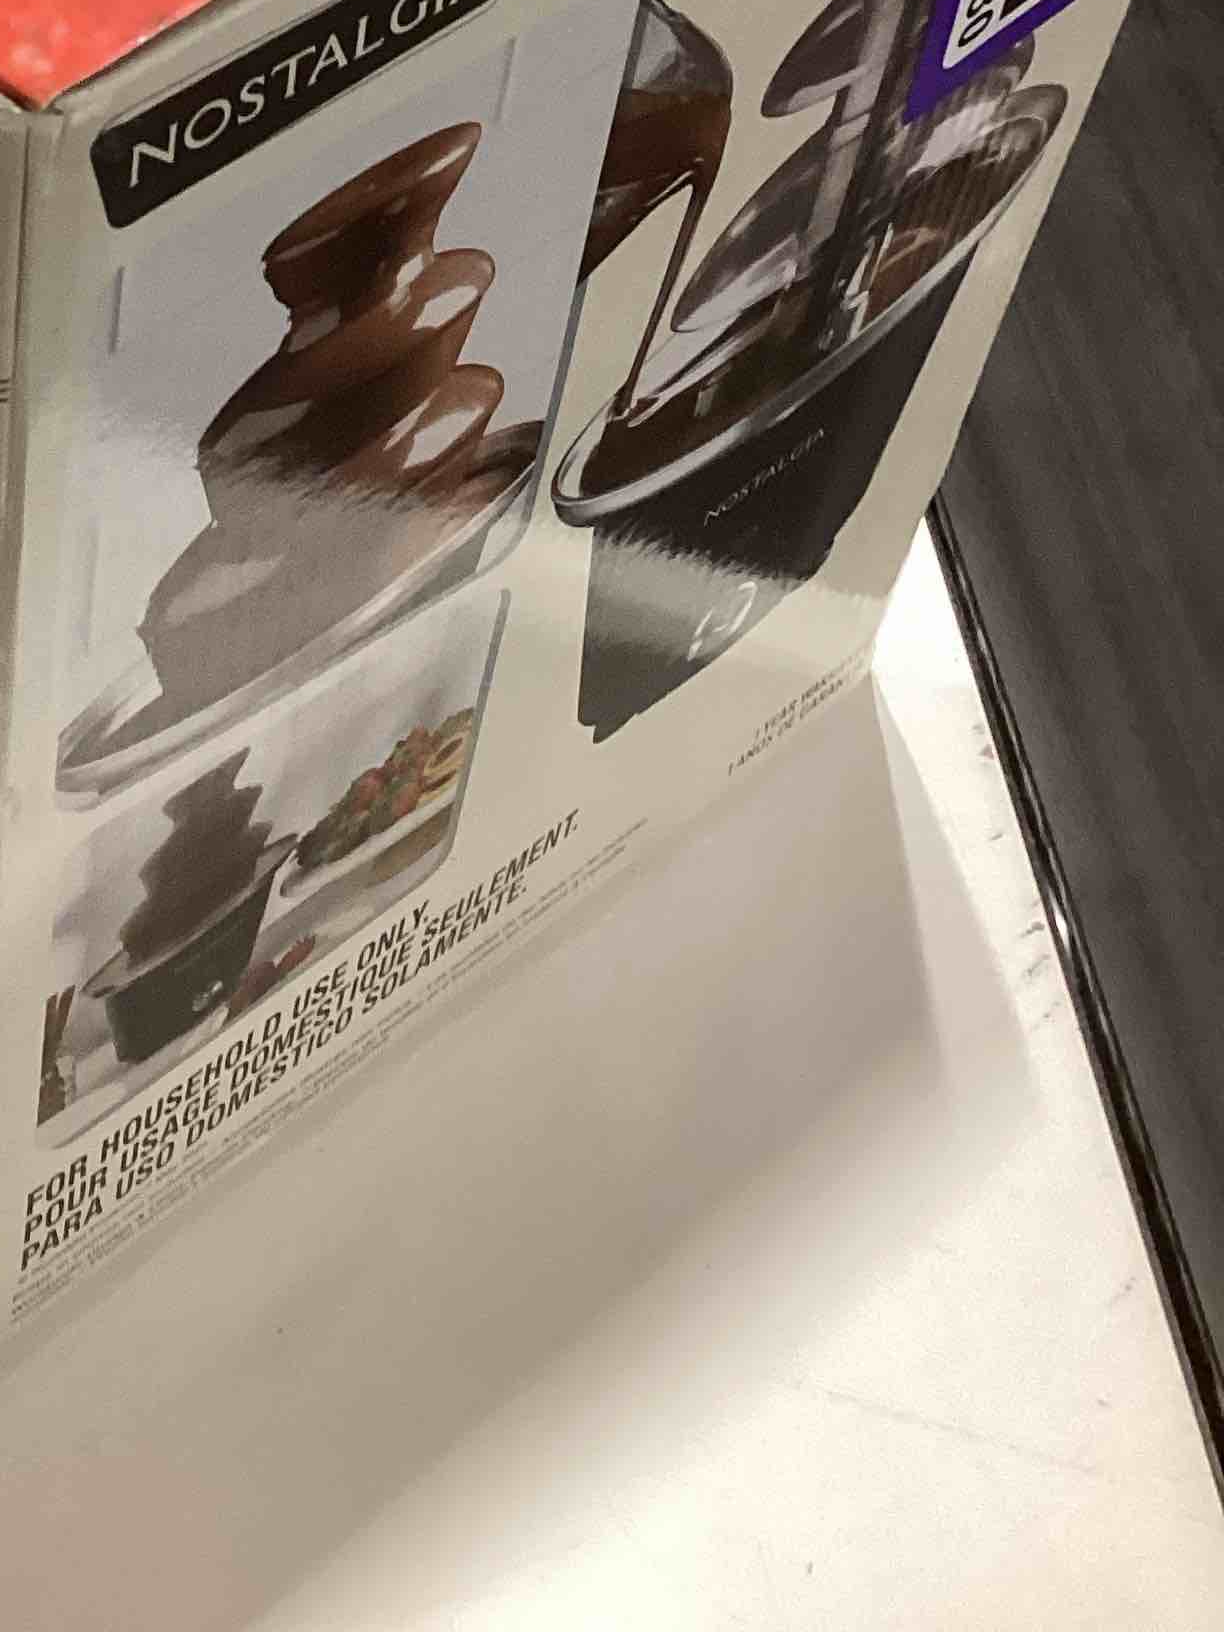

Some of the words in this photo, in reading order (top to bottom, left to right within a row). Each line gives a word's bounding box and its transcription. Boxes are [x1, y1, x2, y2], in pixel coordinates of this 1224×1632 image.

[21, 1196, 103, 1272] PARA
[115, 1141, 175, 1200] USO
[186, 1006, 353, 1149] DOMESTICO
[361, 874, 528, 1015] SOLAMENTE.
[24, 1166, 107, 1244] POUR
[120, 1081, 221, 1173] USAGE
[231, 935, 415, 1092] DOMESTIQUE
[421, 808, 579, 948] SEULEMENT.
[26, 1154, 88, 1217] FOR
[100, 1011, 282, 1164] HOUSEHOLD
[292, 961, 348, 1019] USE
[357, 899, 429, 970] ONLY.
